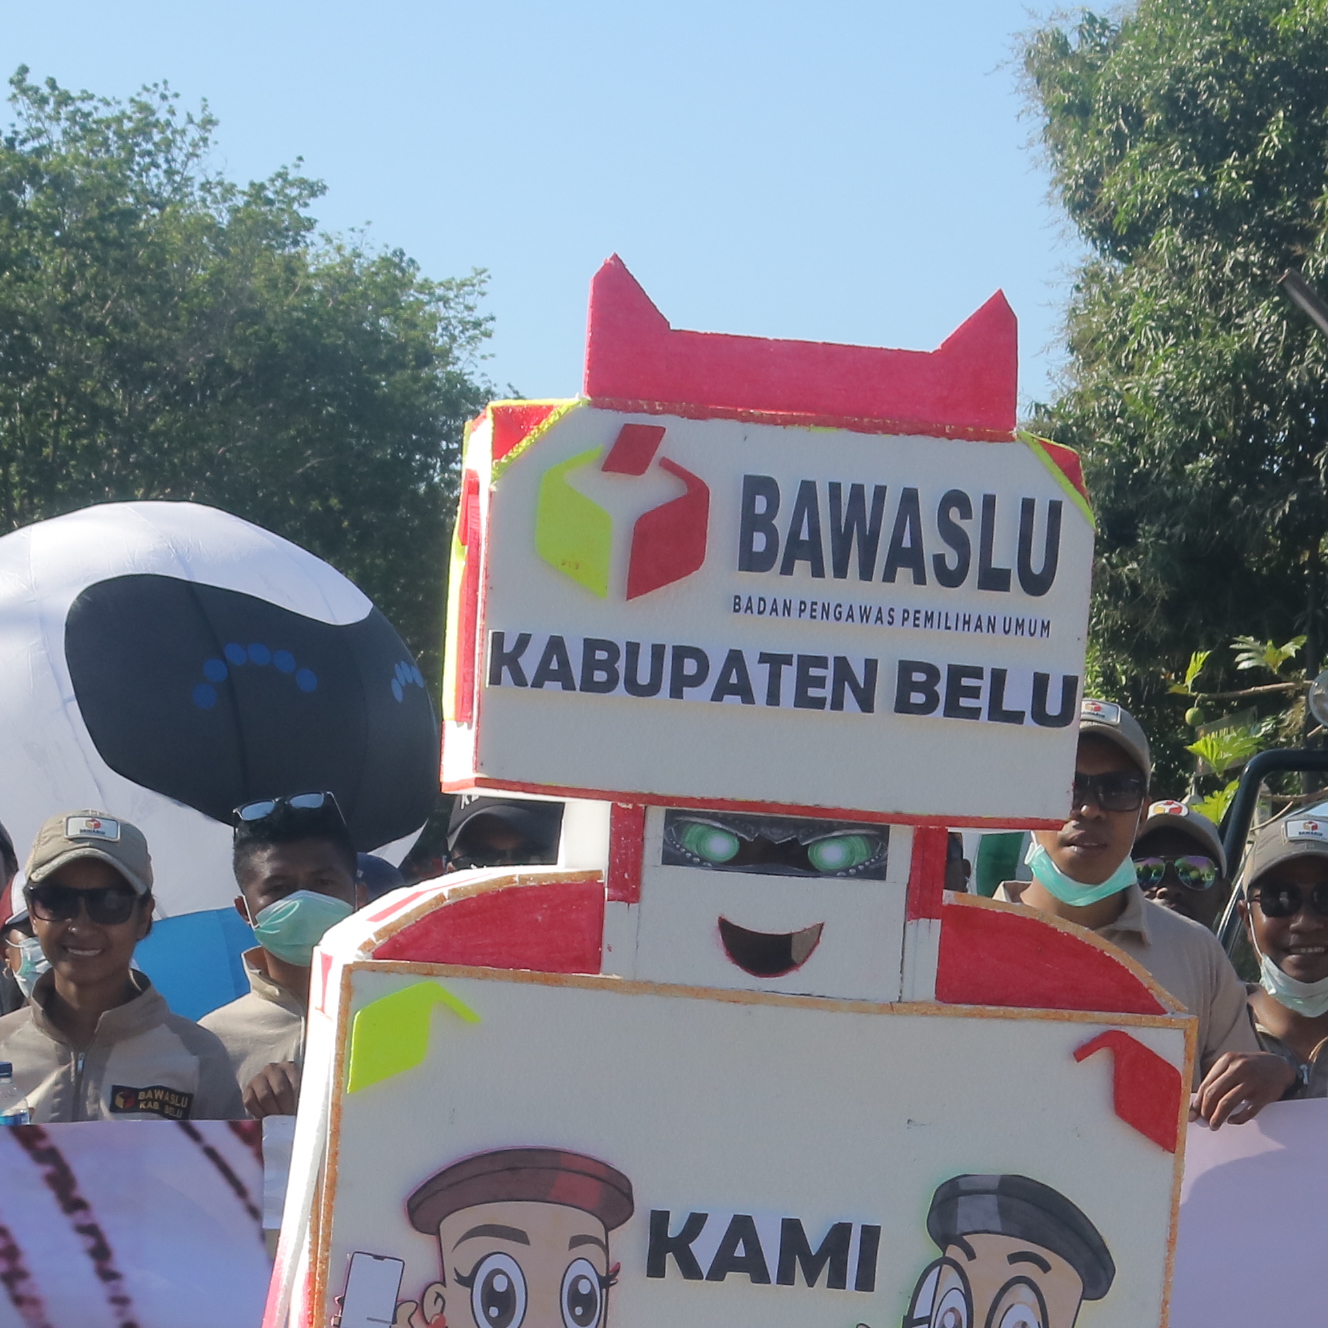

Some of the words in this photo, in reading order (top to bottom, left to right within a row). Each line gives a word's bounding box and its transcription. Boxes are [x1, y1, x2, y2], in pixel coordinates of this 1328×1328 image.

[737, 473, 1063, 598] BAWASLU
[732, 594, 793, 618] BADAN
[798, 600, 895, 626] PENGAWAS
[900, 608, 997, 634] PEMILIHAN
[1002, 616, 1051, 639] UMUM
[488, 631, 879, 714] KABUPATEN
[893, 659, 1079, 729] BELU
[138, 1089, 189, 1108] BAWASLU
[645, 1210, 883, 1294] KAMI
